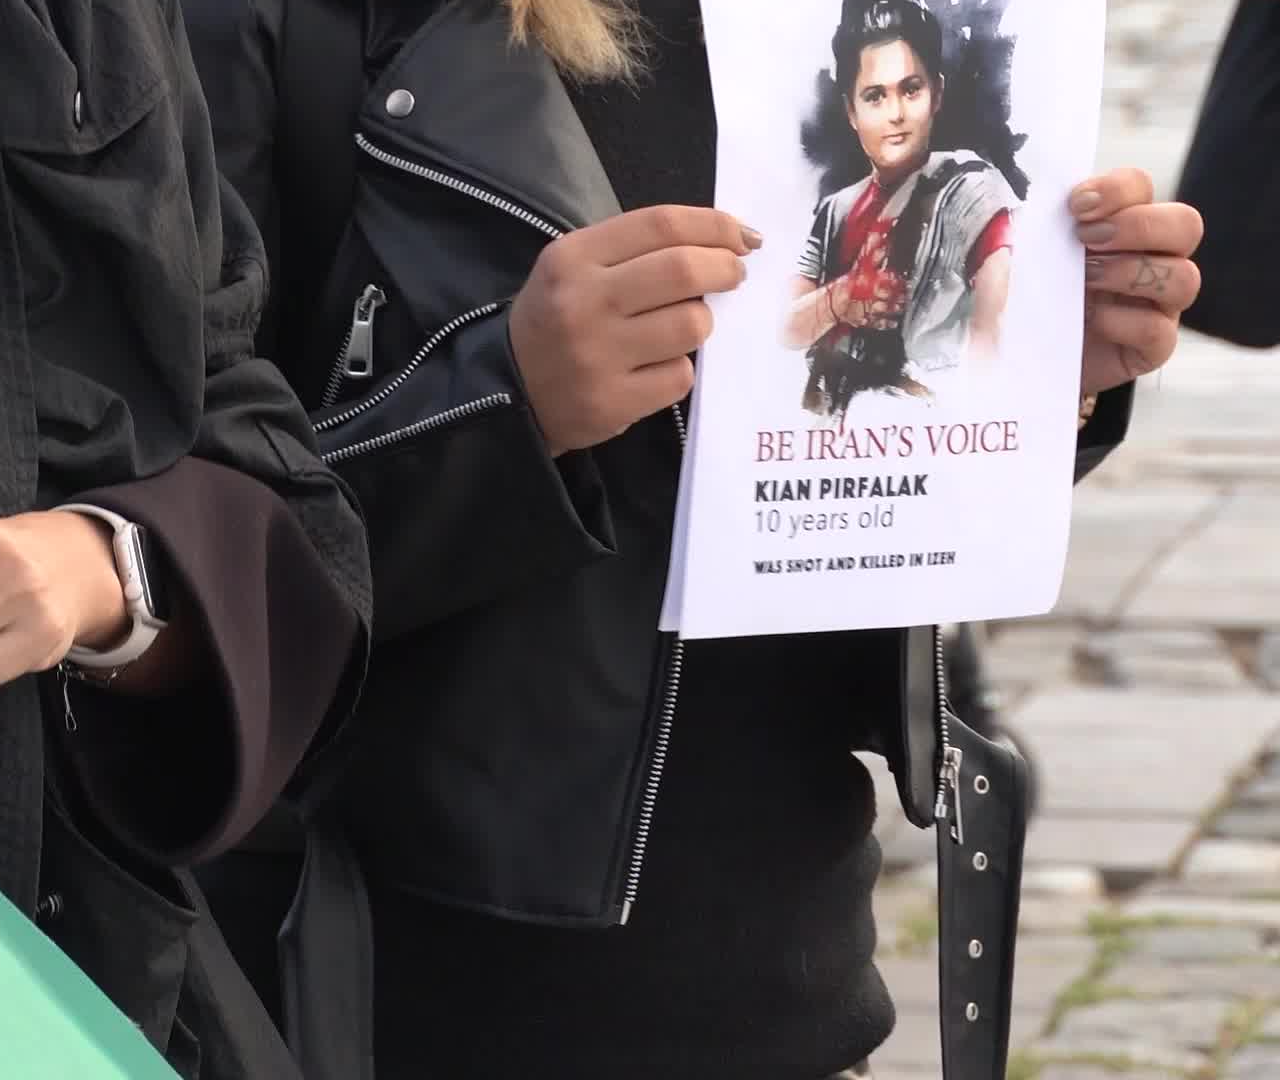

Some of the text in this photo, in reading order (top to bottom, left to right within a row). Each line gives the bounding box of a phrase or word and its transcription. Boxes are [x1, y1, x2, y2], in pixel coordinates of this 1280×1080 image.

[755, 420, 1019, 462] BE IRAN'S VOICE
[754, 474, 928, 502] KIAN PIRFALAK
[755, 504, 894, 539] 10 years old
[753, 551, 956, 575] WAS SHOT AND KILLED IN IZEH
